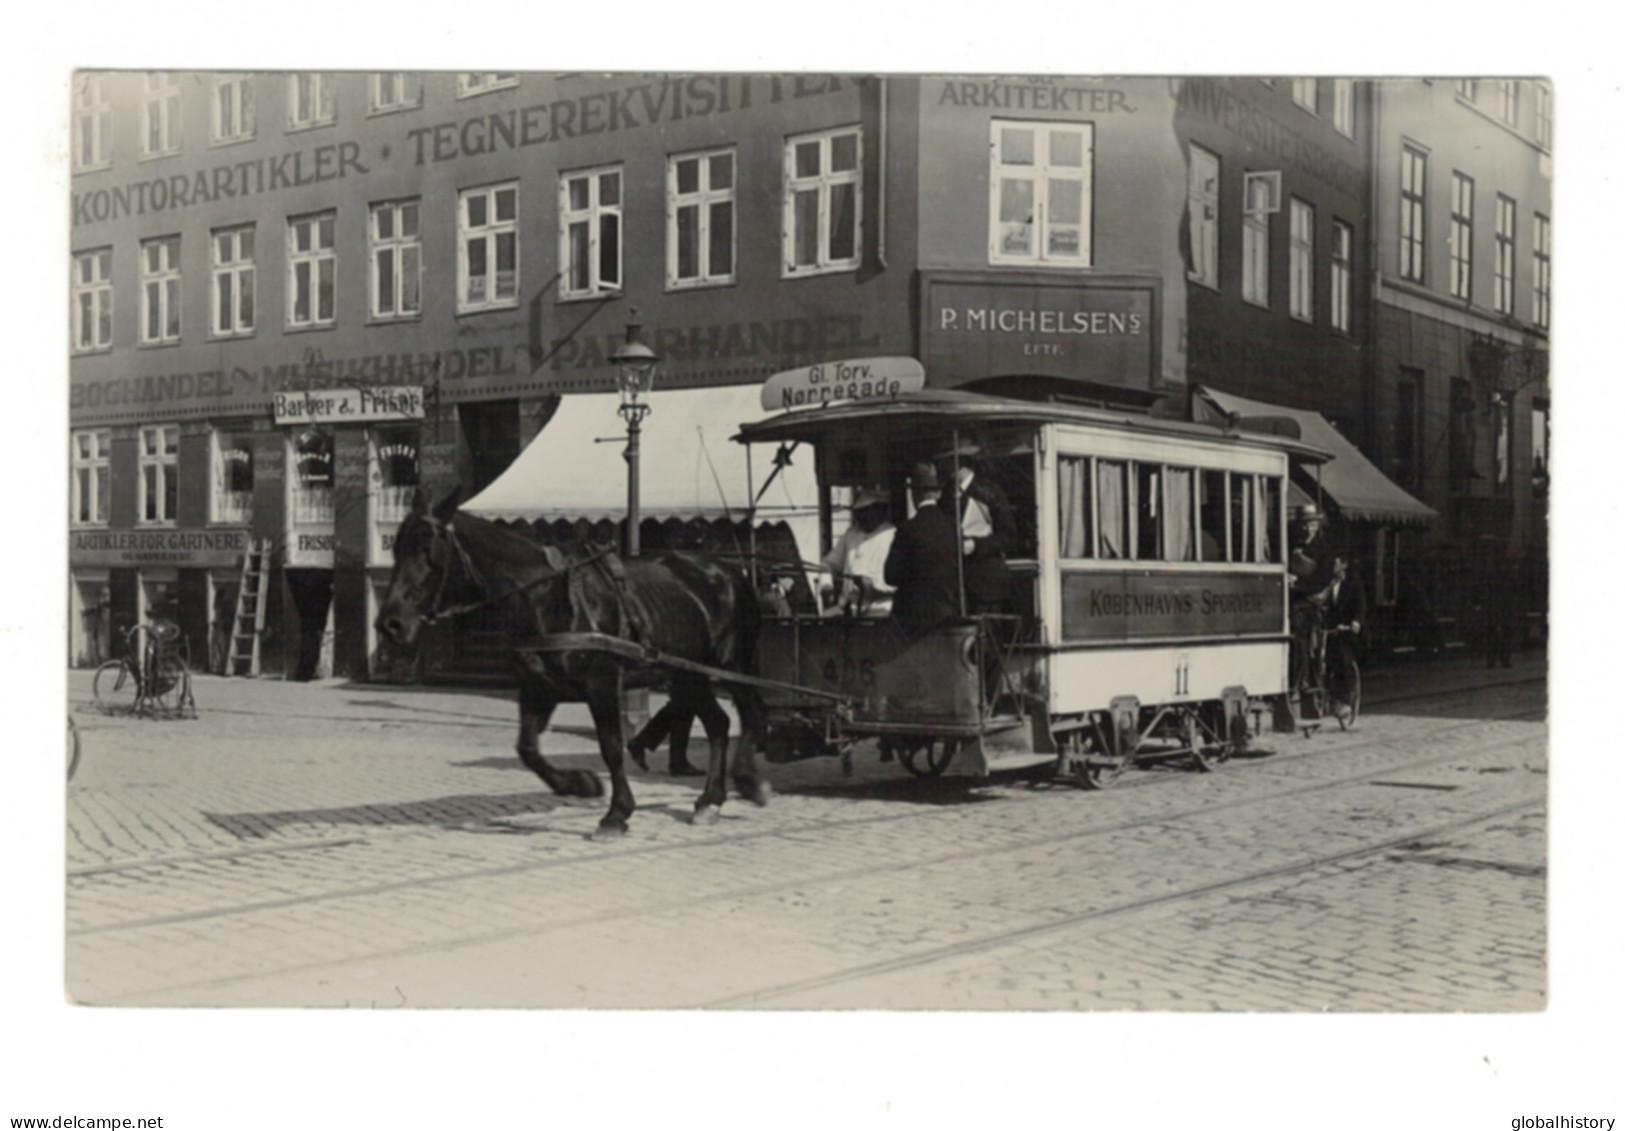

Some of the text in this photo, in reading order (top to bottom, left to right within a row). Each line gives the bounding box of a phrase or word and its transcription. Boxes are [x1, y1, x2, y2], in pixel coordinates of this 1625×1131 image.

[938, 78, 1138, 114] ARKITEKTER
[72, 141, 370, 225] KONTORARTIKLER
[940, 308, 958, 330] P.
[70, 370, 234, 409] BOGHANDEL
[262, 345, 517, 393] MUSIKHANDEL
[809, 362, 874, 385] Gl. Torv.
[275, 391, 335, 418] Barber
[338, 397, 354, 415] &
[76, 533, 244, 550] ARTIKLER FOR GARTNERE
[1090, 588, 1193, 617] KØBENHAVNS
